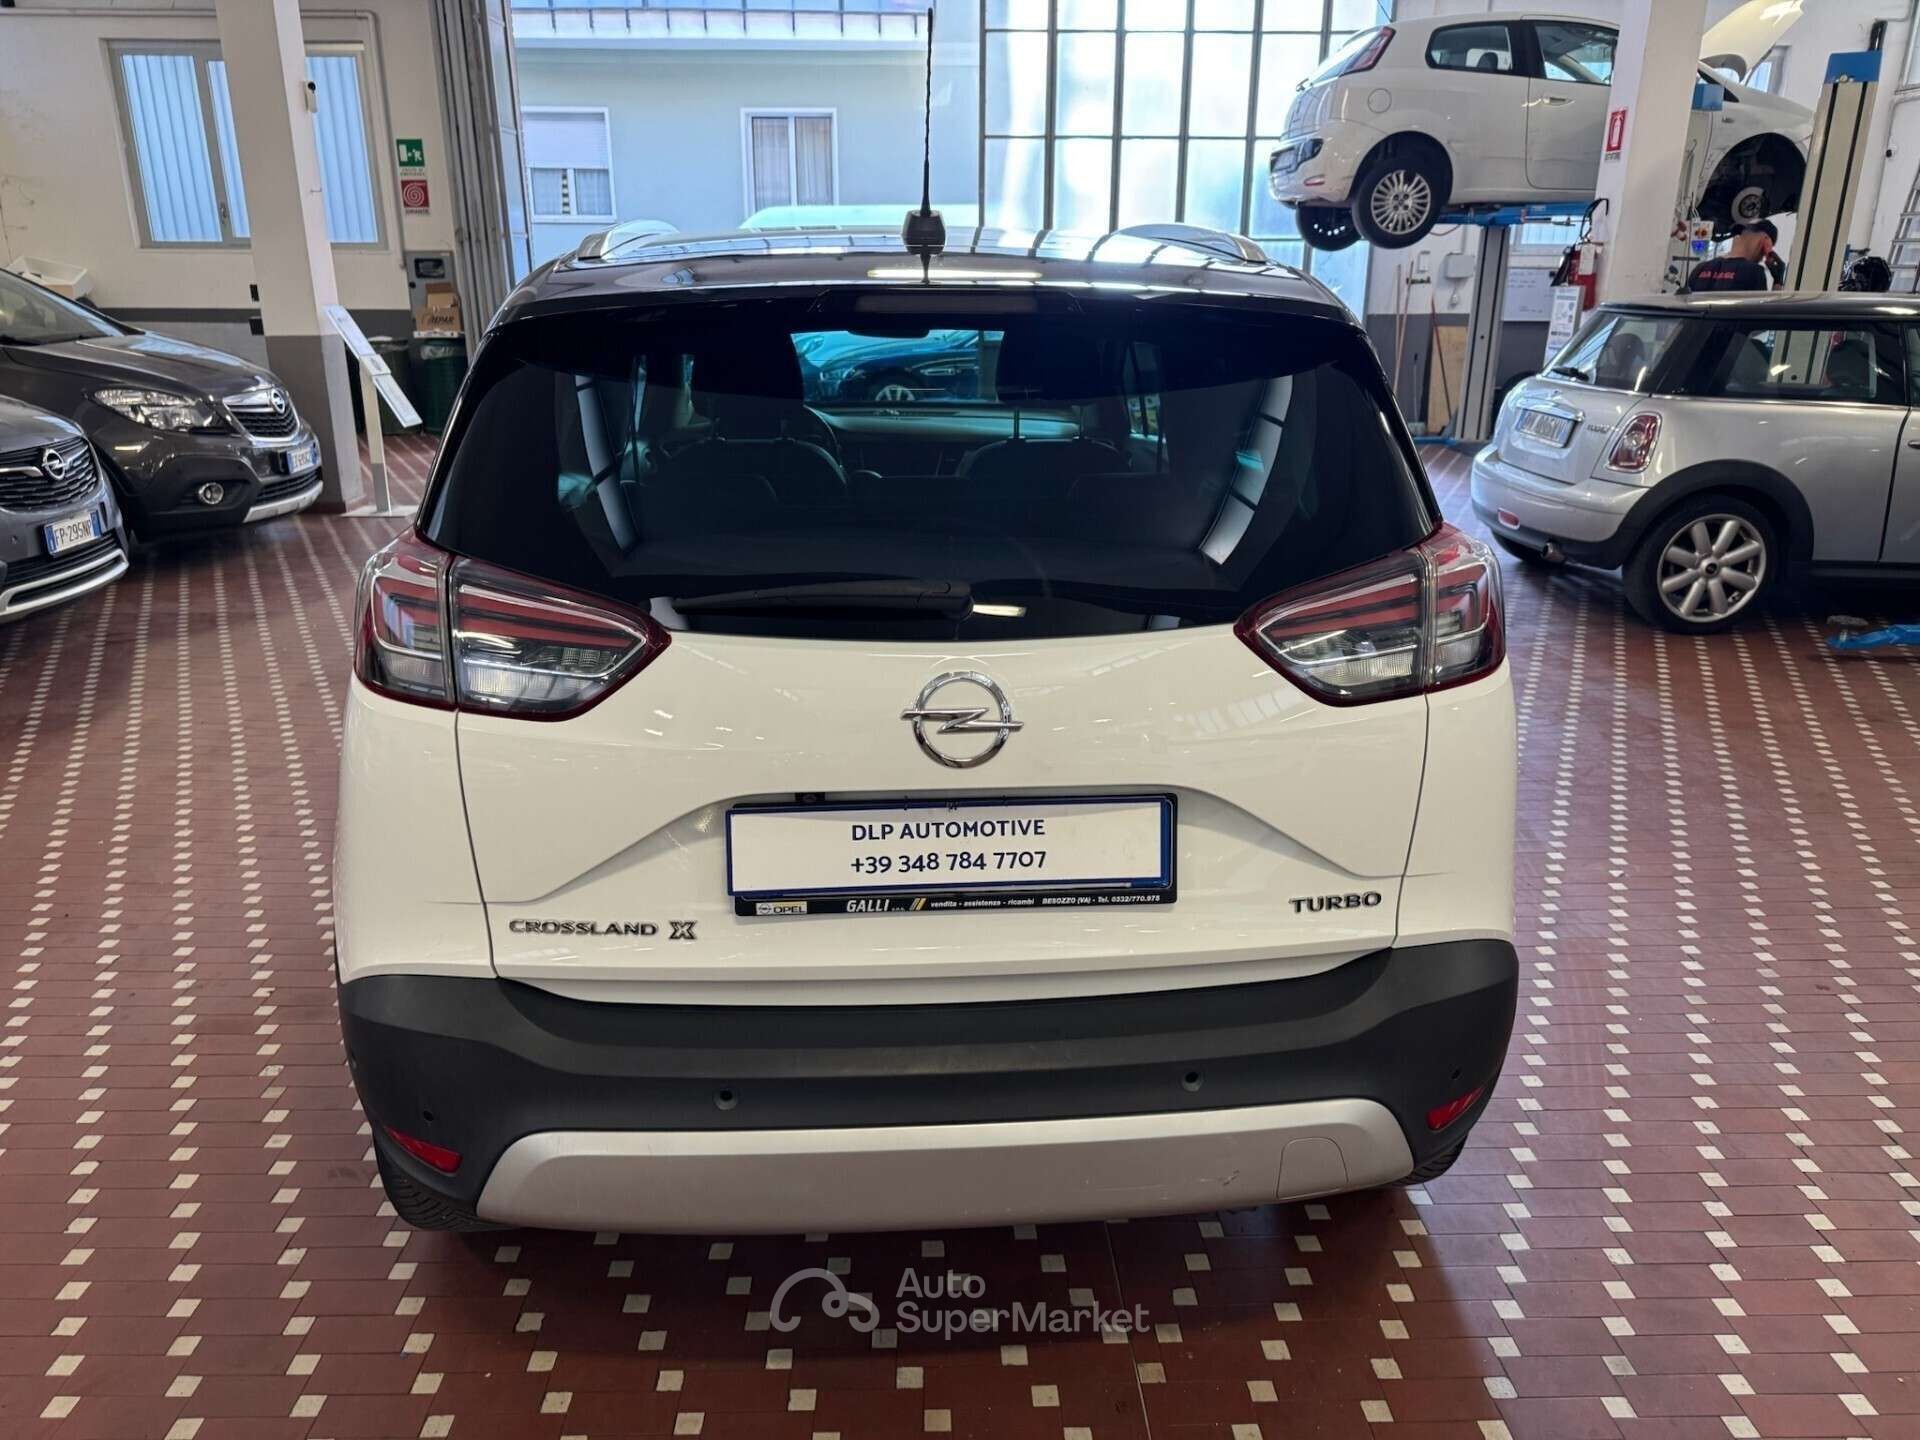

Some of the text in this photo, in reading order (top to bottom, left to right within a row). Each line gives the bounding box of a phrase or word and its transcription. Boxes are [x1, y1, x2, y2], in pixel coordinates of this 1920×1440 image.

[851, 819, 1046, 841] DLP AUTOMOTIVE
[850, 851, 1047, 874] +39 348 784 7707
[773, 905, 806, 914] OPEL
[846, 898, 890, 913] GALLI
[930, 900, 957, 908] vendita
[1007, 898, 1035, 906] ricambi
[1288, 890, 1382, 914] TURBO
[508, 918, 698, 940] CROSSLAND X
